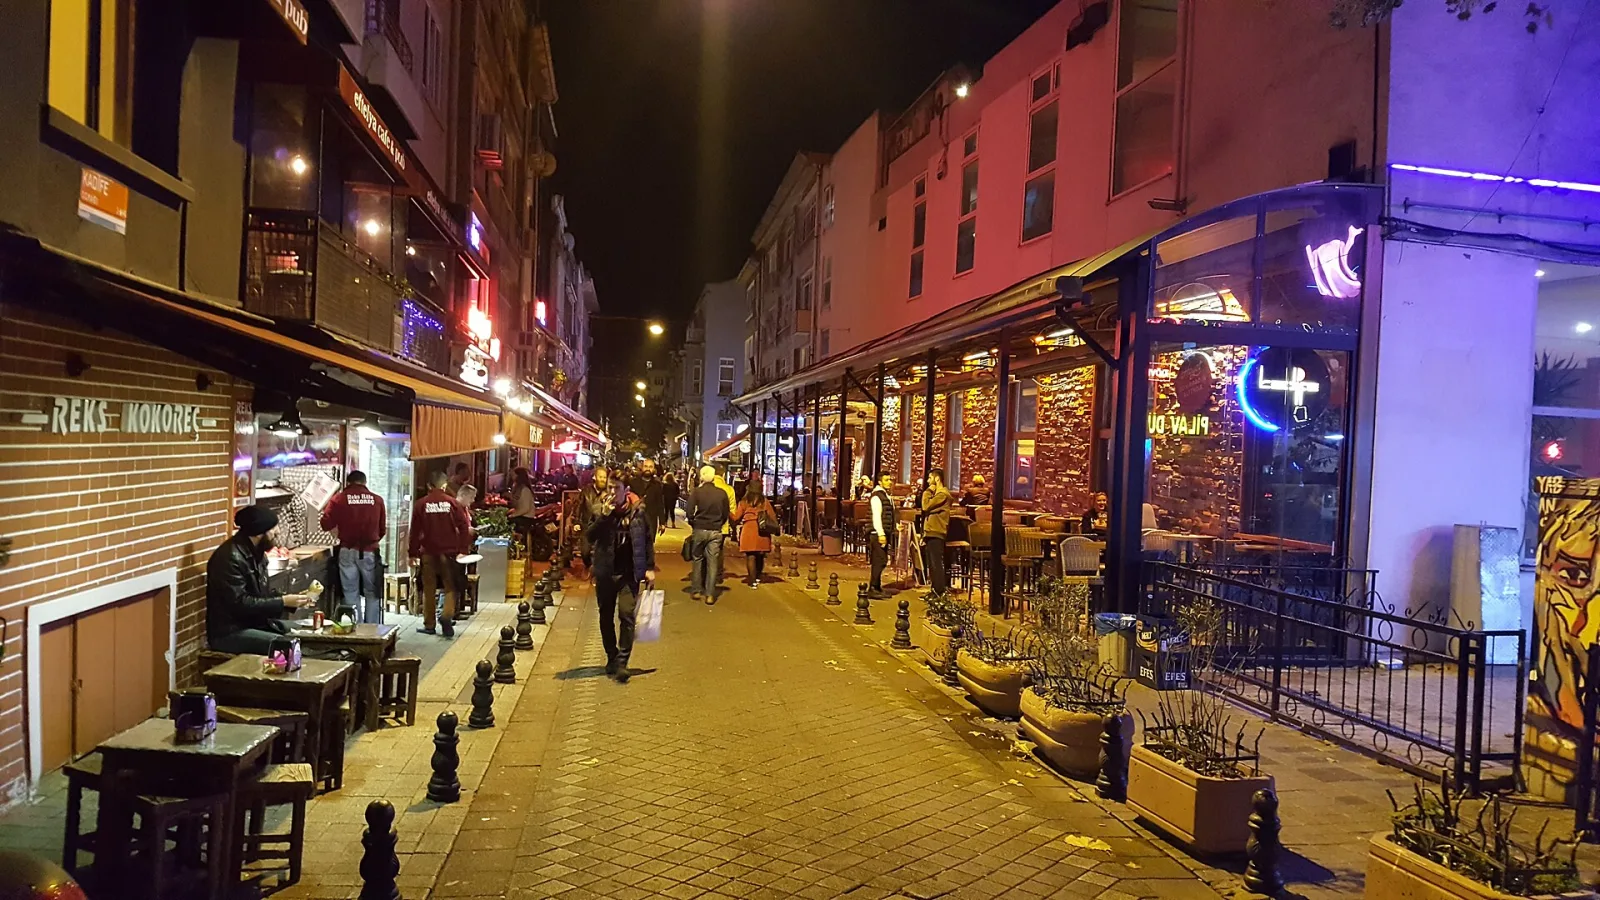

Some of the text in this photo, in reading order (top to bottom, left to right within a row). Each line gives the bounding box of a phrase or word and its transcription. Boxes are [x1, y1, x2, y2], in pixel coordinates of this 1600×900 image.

[284, 0, 308, 35] pub
[52, 397, 200, 442] REKS KOKOREÇ
[1139, 665, 1154, 680] EFES
[1165, 672, 1186, 681] EFES
